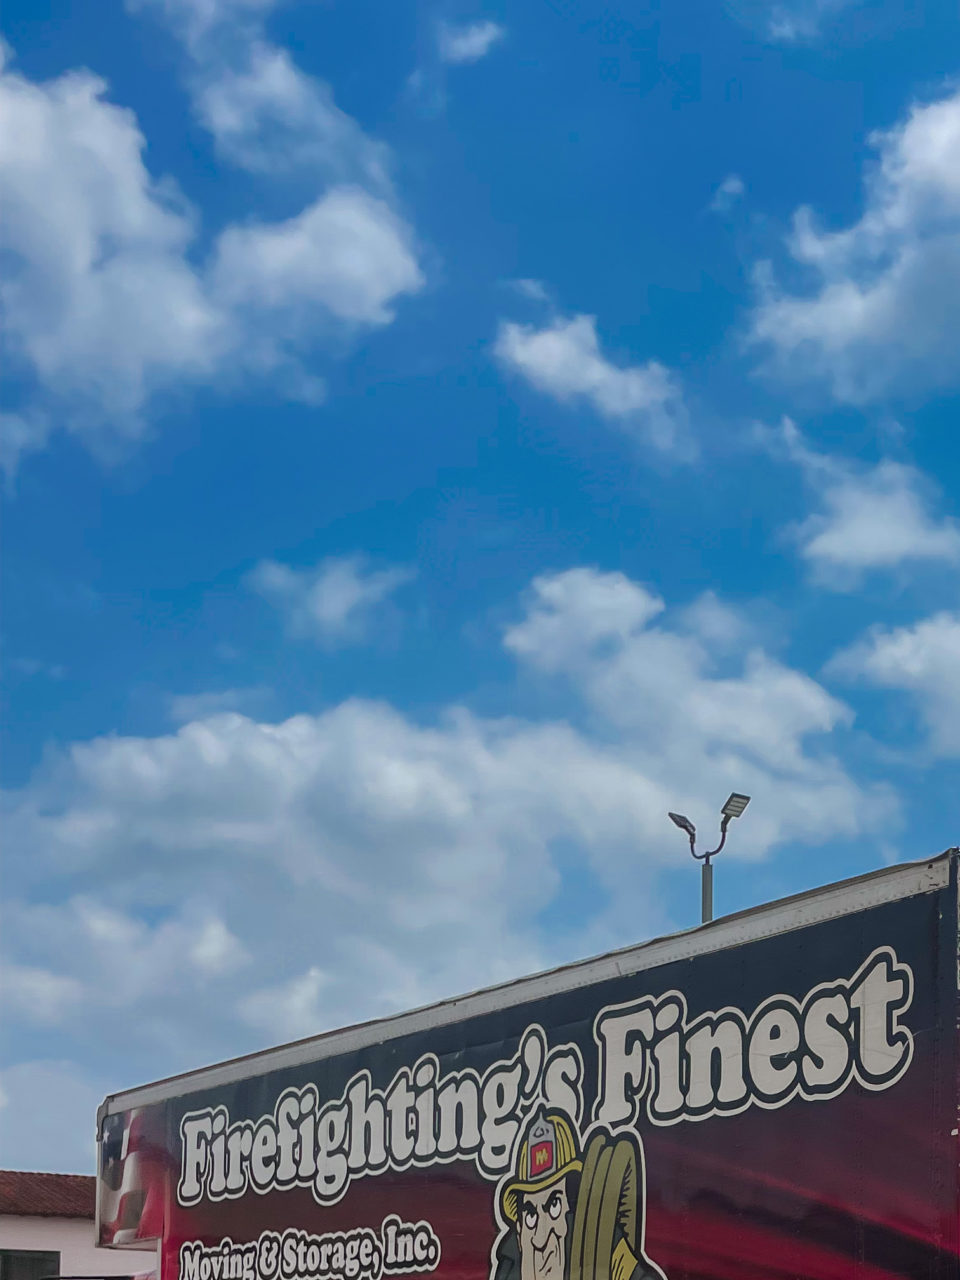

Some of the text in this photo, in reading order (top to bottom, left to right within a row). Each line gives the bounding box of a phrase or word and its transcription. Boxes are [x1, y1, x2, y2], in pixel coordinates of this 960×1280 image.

[180, 960, 906, 1199] Firefighting's Finest
[259, 1240, 280, 1277] &
[385, 1224, 437, 1265] Inc.
